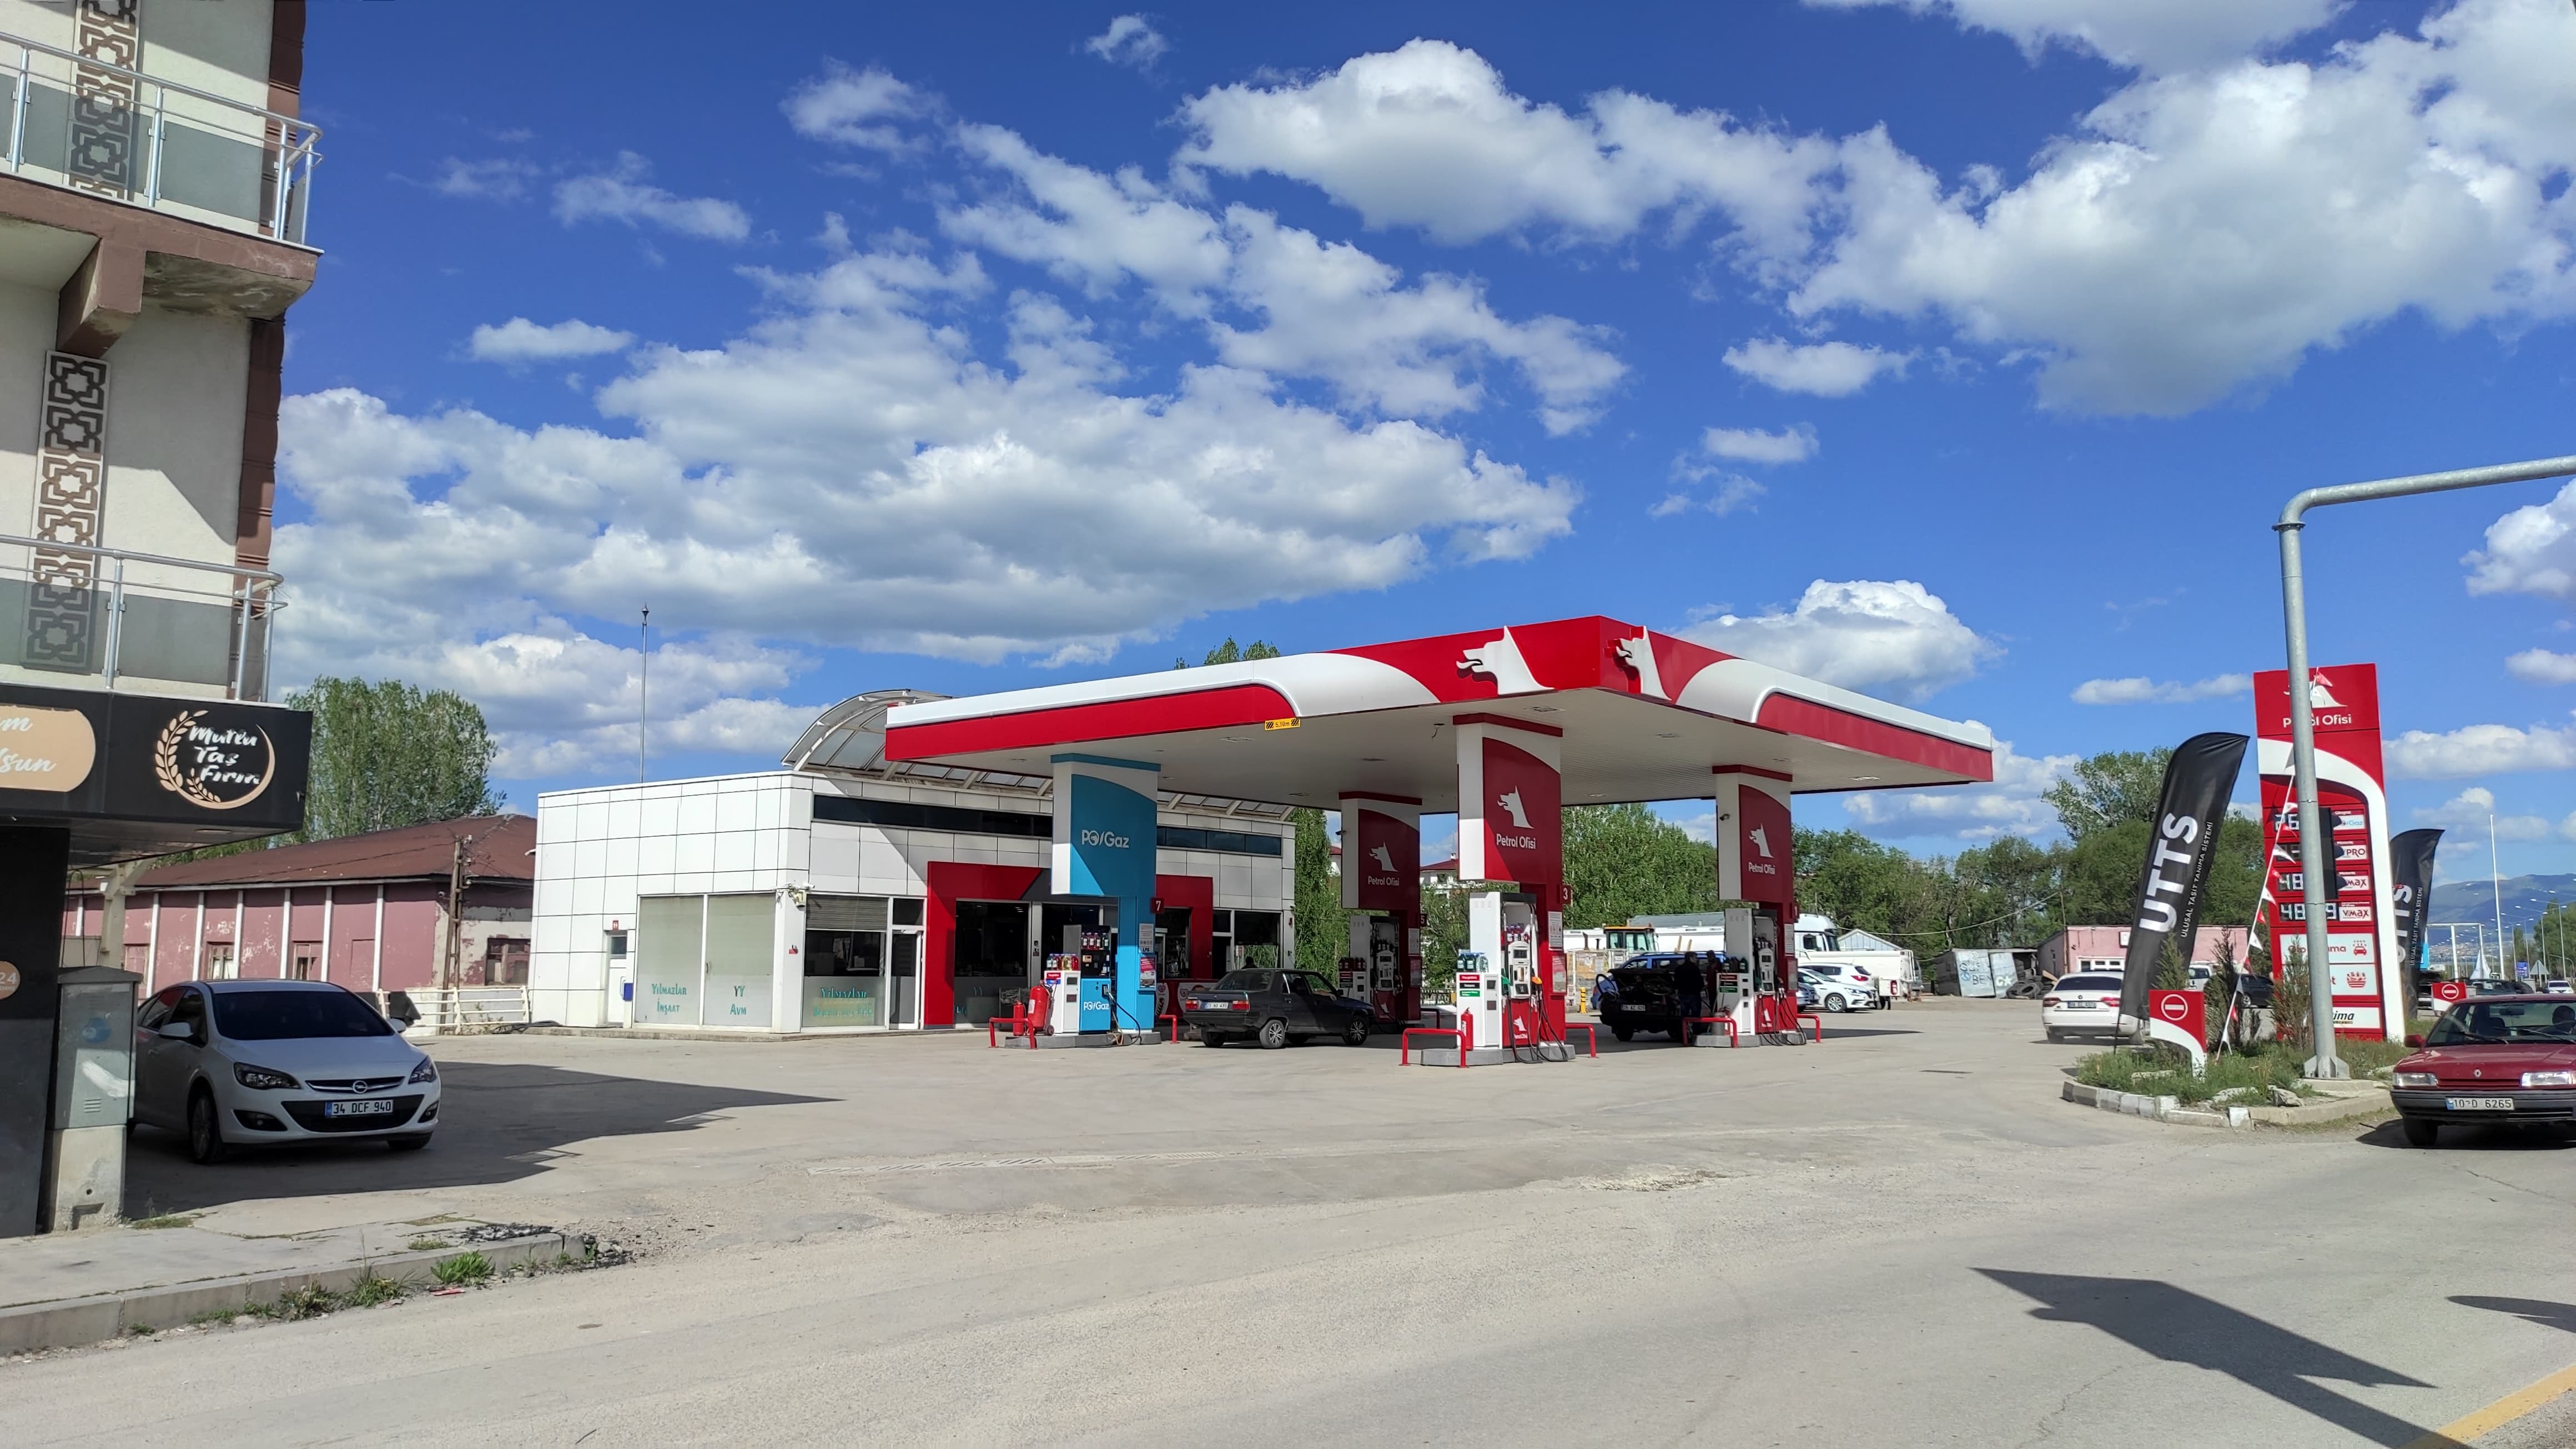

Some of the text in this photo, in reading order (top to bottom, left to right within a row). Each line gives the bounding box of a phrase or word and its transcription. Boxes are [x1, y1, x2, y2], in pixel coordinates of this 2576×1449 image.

[2283, 713, 2352, 728] Pol Ofisi
[189, 725, 258, 746] Mutlu
[194, 746, 239, 766] Taş
[1496, 833, 1536, 849] Petrol Ofisi
[1748, 861, 1775, 875] Petrol Ofisi
[2139, 812, 2198, 933] UTTS
[1368, 876, 1400, 886] Petrol Ofisi
[1563, 888, 1568, 900] 3
[2181, 908, 2193, 938] ULUSAL
[2194, 853, 2206, 882] TANIMA
[1156, 900, 1161, 911] 7
[734, 985, 746, 997] YY
[333, 1101, 391, 1114] 34 DCF 940
[2485, 1099, 2511, 1108] 6265
